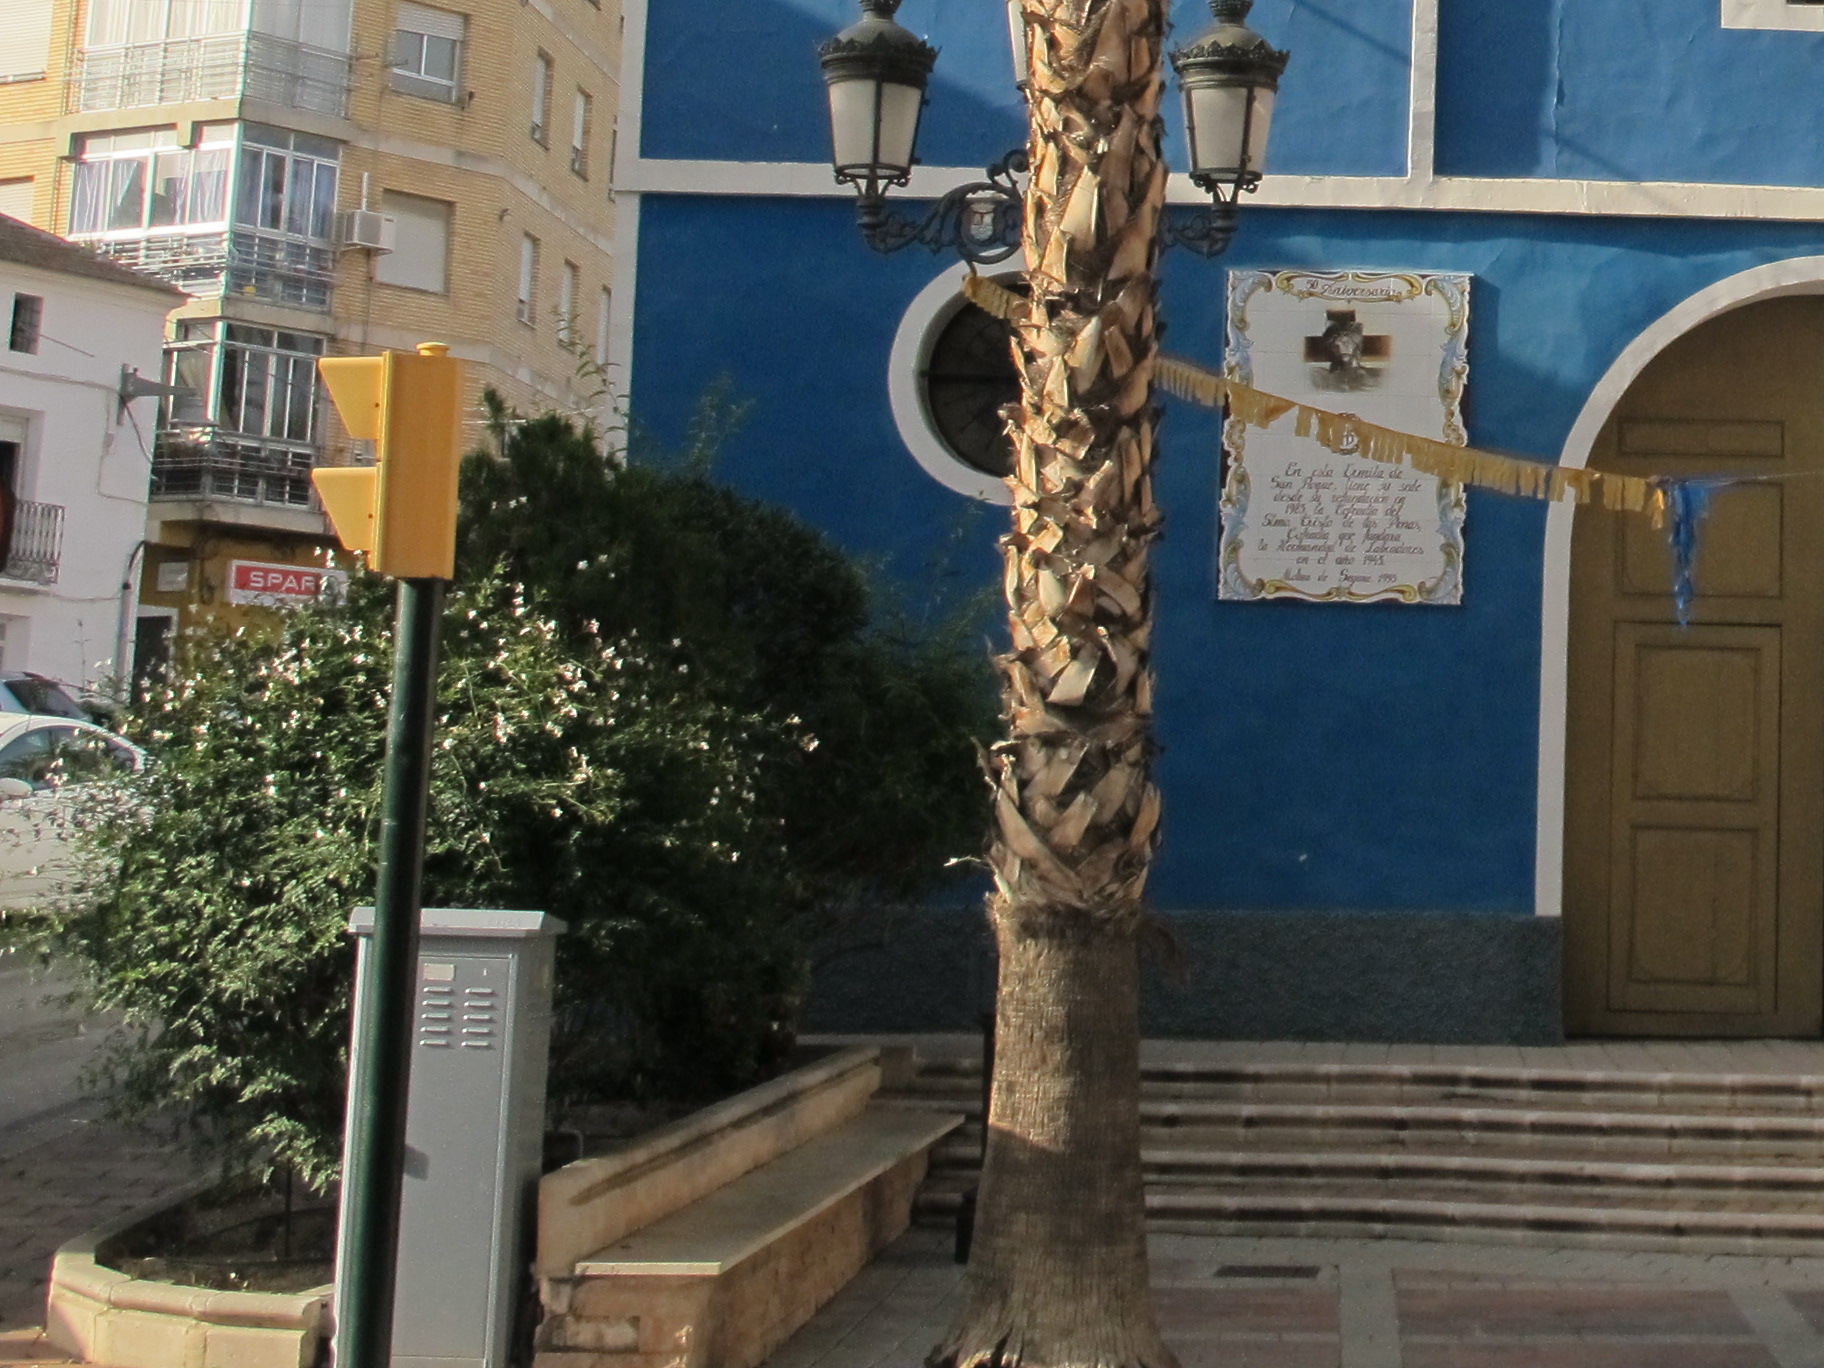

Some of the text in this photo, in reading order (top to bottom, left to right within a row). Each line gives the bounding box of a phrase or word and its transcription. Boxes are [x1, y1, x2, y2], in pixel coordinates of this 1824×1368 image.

[1320, 281, 1400, 296] Aniversario
[1285, 462, 1403, 479] En esta Ermita de
[1271, 477, 1293, 489] San
[1377, 481, 1391, 492] su
[1398, 479, 1423, 492] sede
[1273, 490, 1303, 502] desde
[1313, 502, 1325, 515] la
[1384, 503, 1404, 517] del
[1301, 514, 1333, 528] Cristo
[1342, 516, 1355, 528] de
[1338, 533, 1356, 546] que
[1344, 540, 1357, 553] de
[1364, 541, 1425, 555] Labradores
[1317, 552, 1329, 565] el
[249, 571, 316, 591] SPAR
[1317, 570, 1329, 582] de
